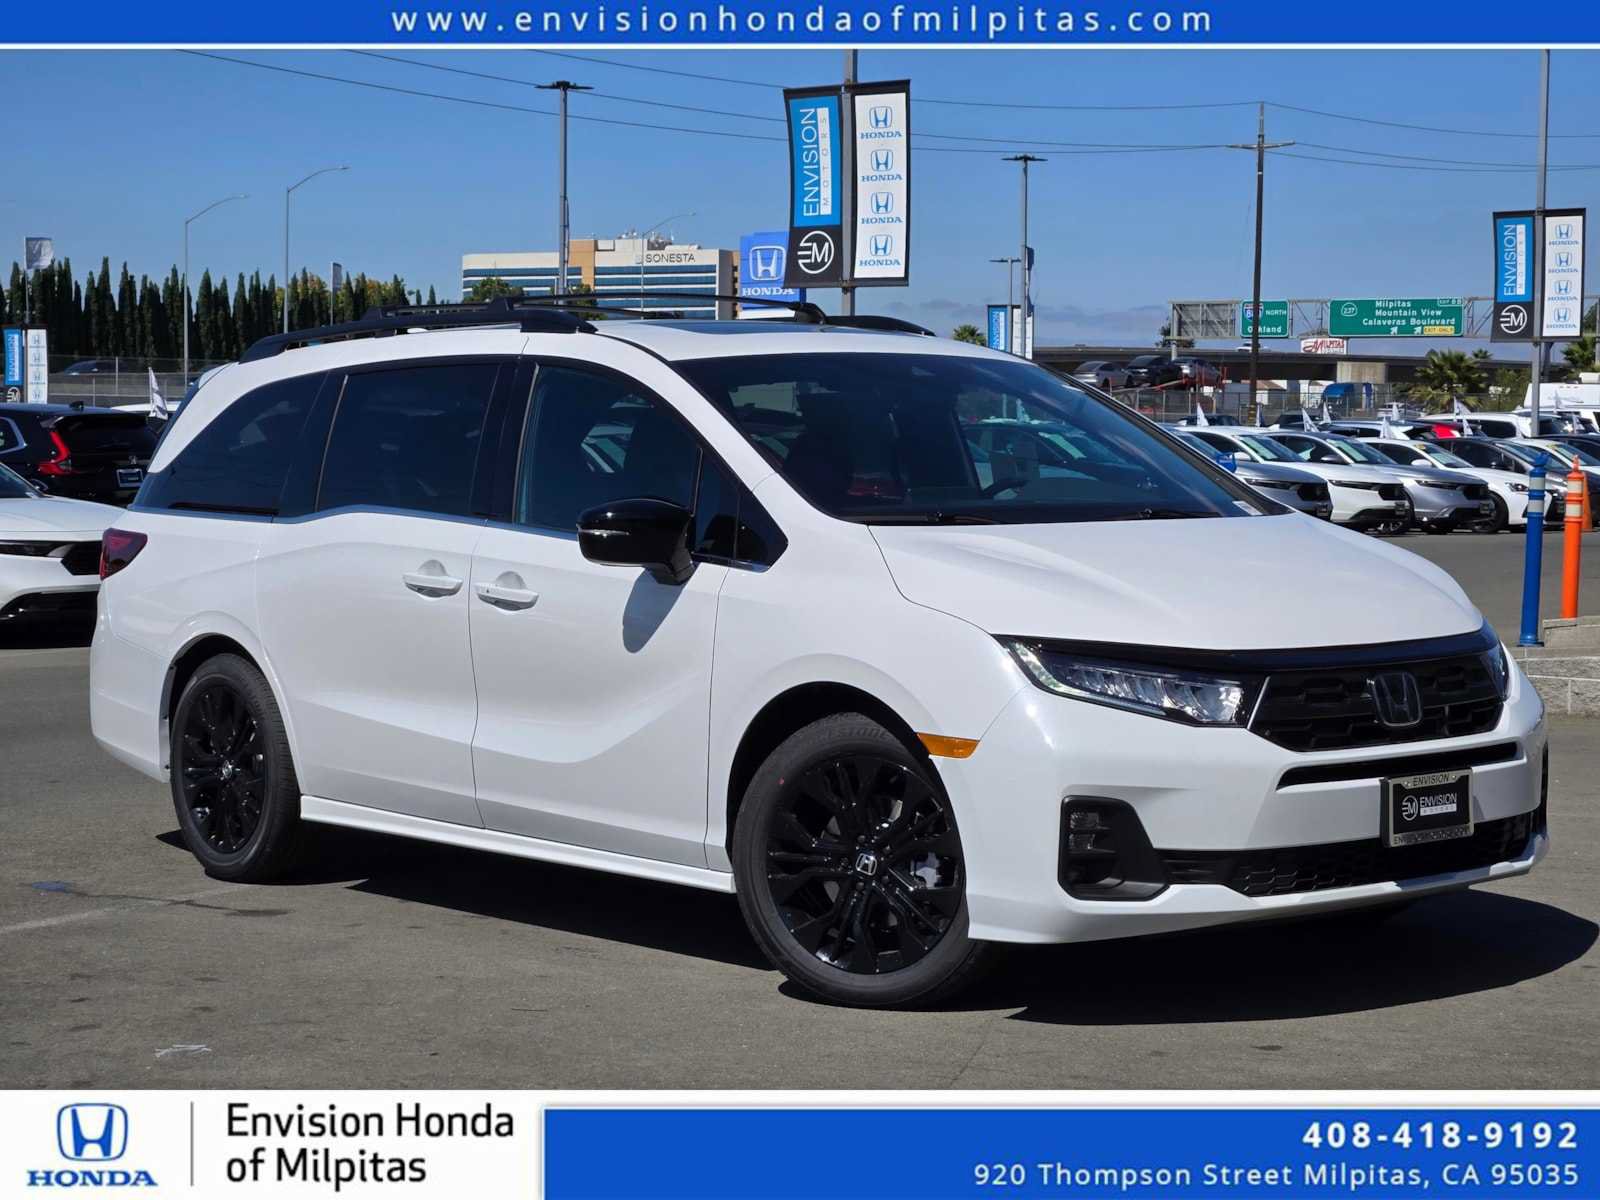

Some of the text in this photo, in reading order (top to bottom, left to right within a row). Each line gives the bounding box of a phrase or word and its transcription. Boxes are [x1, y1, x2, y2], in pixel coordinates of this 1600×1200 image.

[860, 131, 902, 139] HONDA
[800, 108, 819, 217] ENVISION
[861, 174, 903, 182] HONDA
[861, 216, 903, 224] HONDA
[645, 253, 696, 263] SONESTA
[859, 258, 901, 267] HONDA
[1503, 224, 1516, 296] ENVISION
[742, 286, 795, 297] HONDA
[1375, 300, 1411, 308] Milpitas
[1362, 318, 1455, 326] Calaveras Boulevard
[1413, 773, 1450, 787] ENVISION
[1420, 792, 1457, 808] ENVISION
